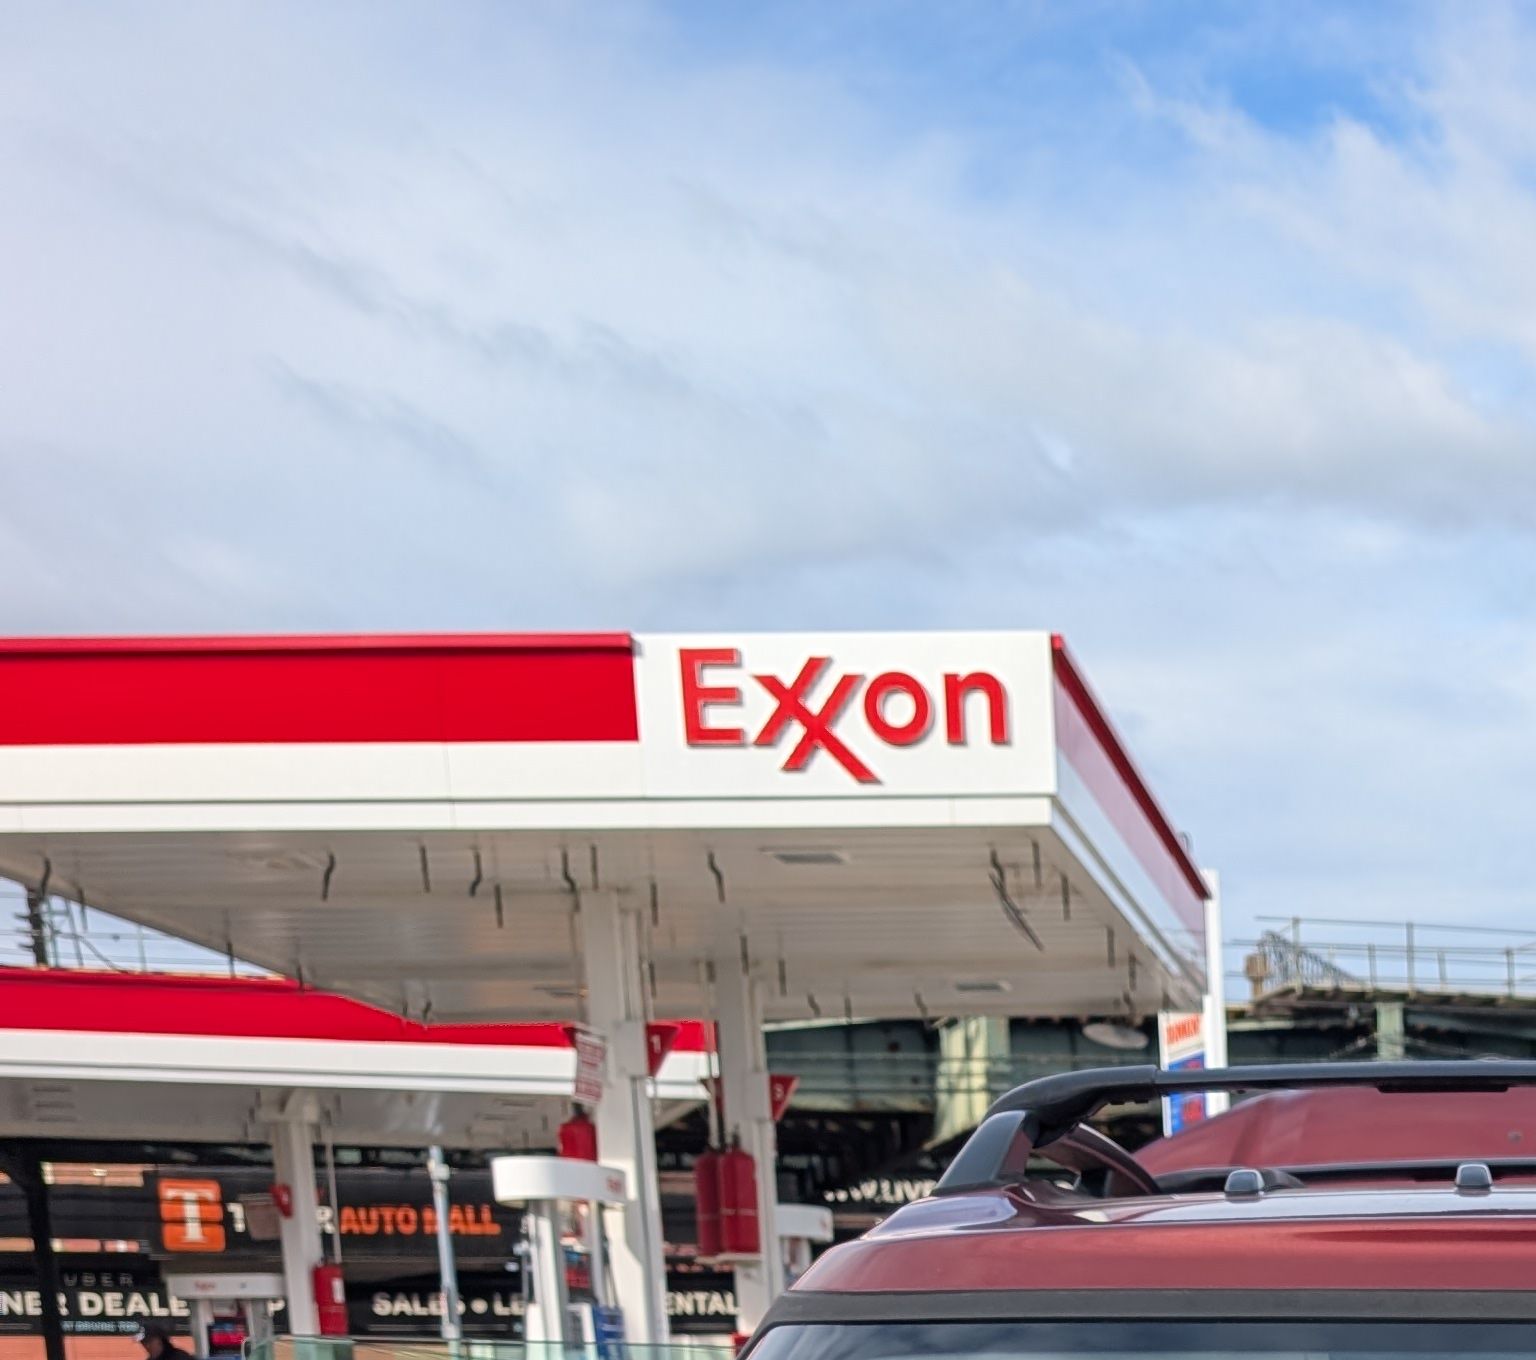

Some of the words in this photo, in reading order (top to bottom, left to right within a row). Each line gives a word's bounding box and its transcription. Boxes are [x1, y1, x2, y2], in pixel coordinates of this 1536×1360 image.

[678, 648, 1009, 784] Exxon
[166, 1189, 215, 1243] T
[341, 1205, 418, 1236] AUTO
